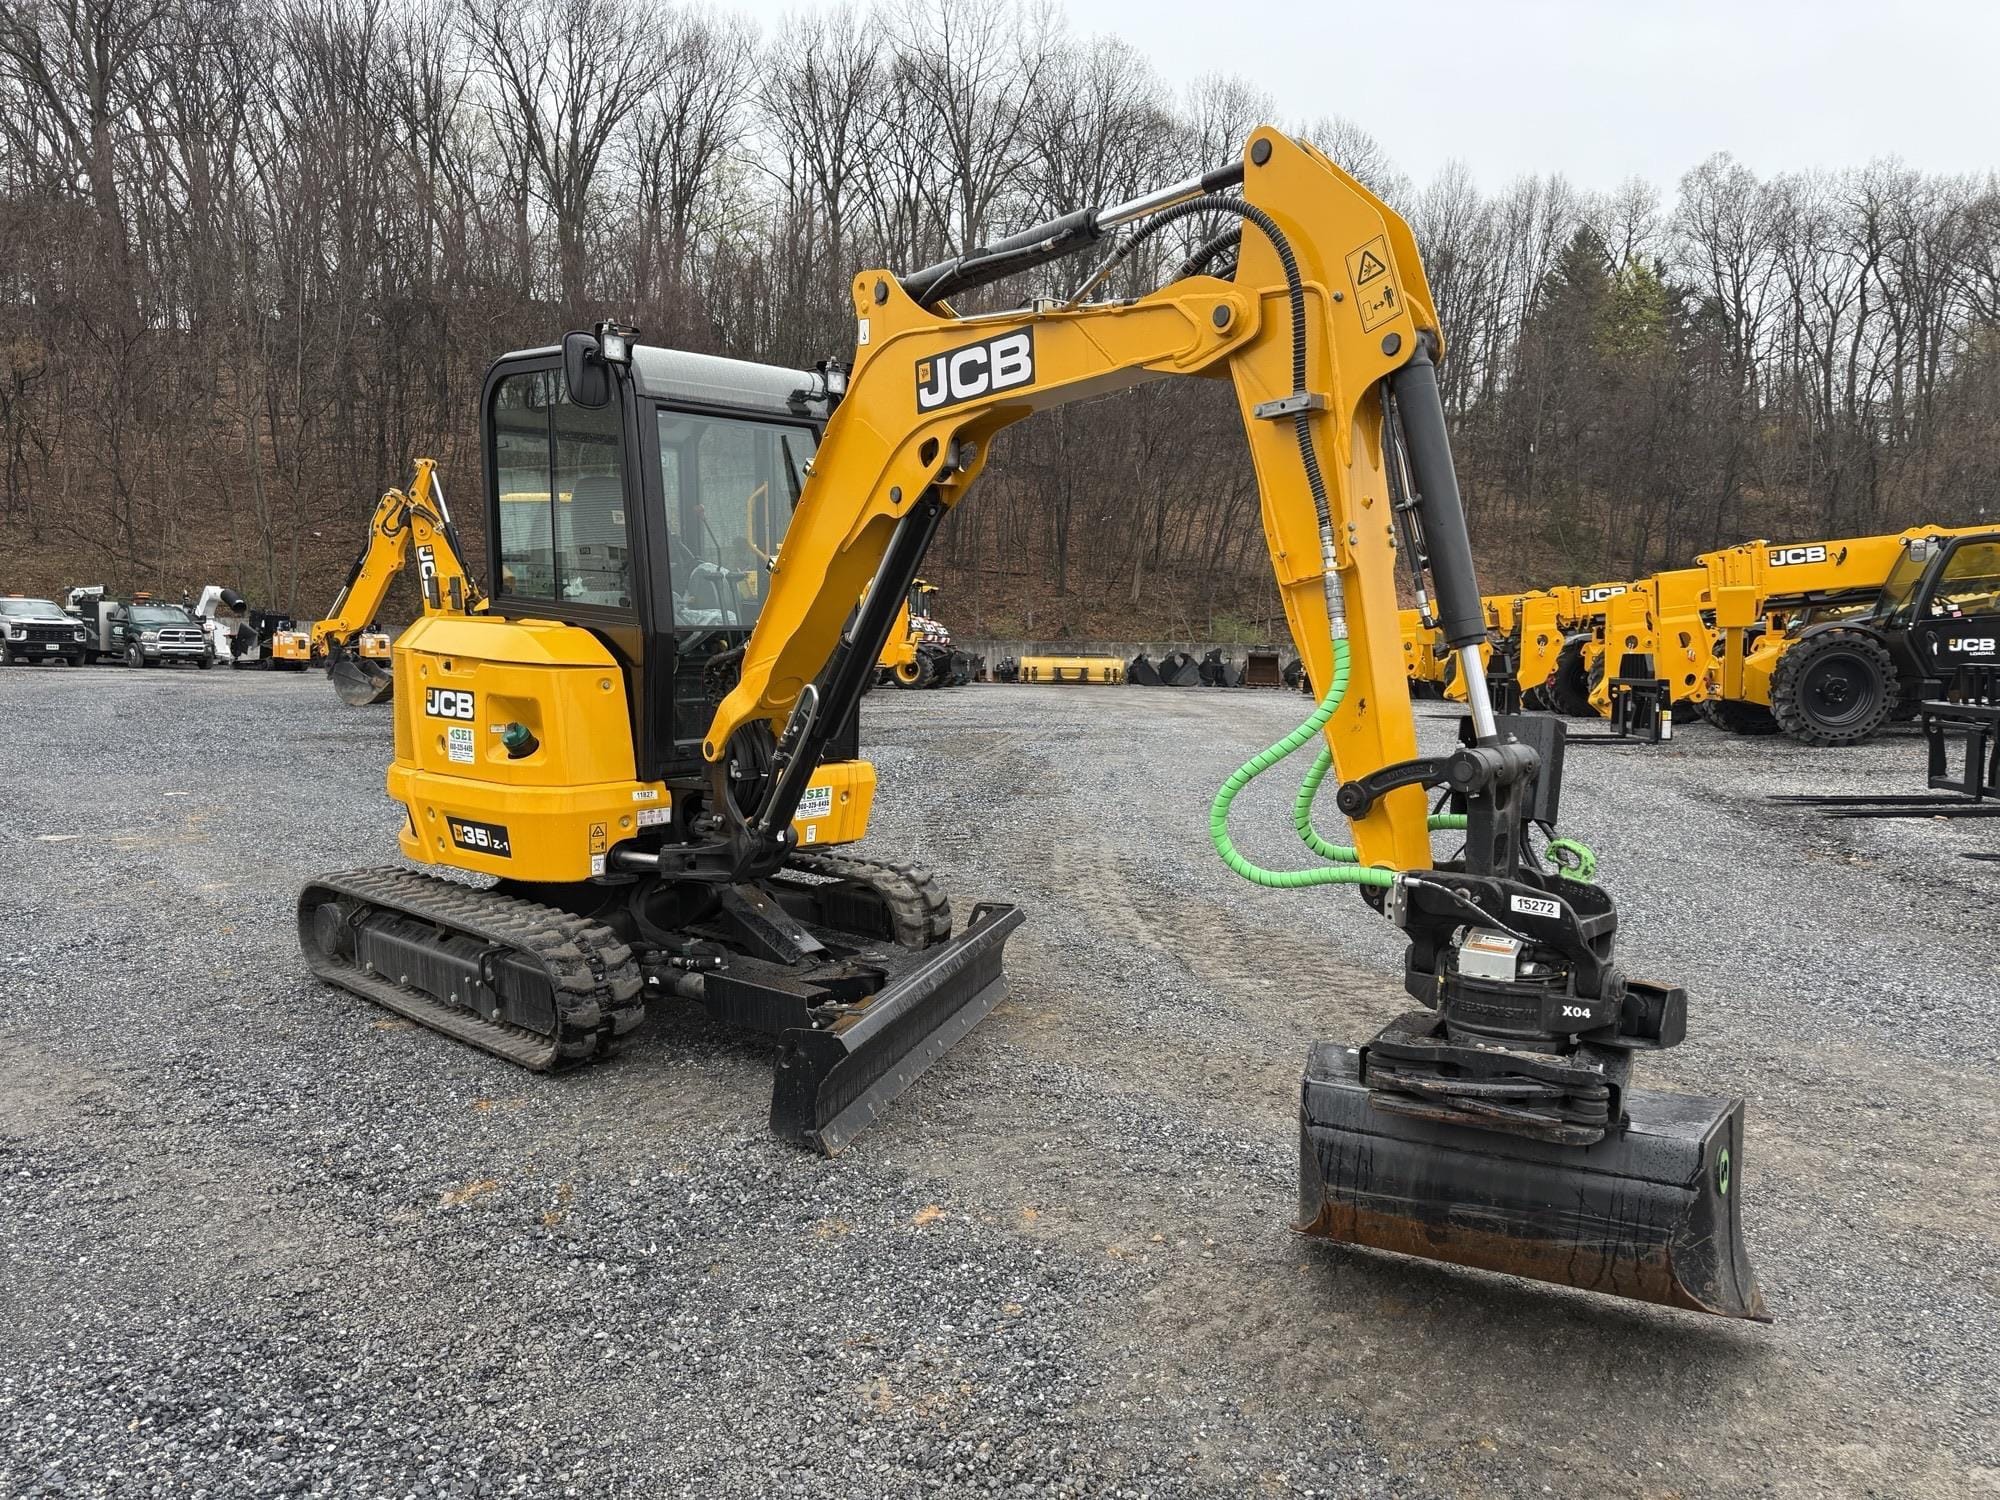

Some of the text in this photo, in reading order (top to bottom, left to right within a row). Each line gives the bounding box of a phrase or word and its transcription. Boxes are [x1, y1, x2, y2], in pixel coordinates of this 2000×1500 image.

[919, 333, 1032, 408] JCB
[1770, 546, 1826, 566] JCB
[1948, 638, 1996, 652] JCB
[426, 689, 474, 719] JCB
[456, 729, 473, 742] SEI
[806, 787, 831, 800] SEI
[462, 825, 489, 847] 35
[1517, 898, 1555, 914] 15272
[1562, 1005, 1592, 1019] X04
